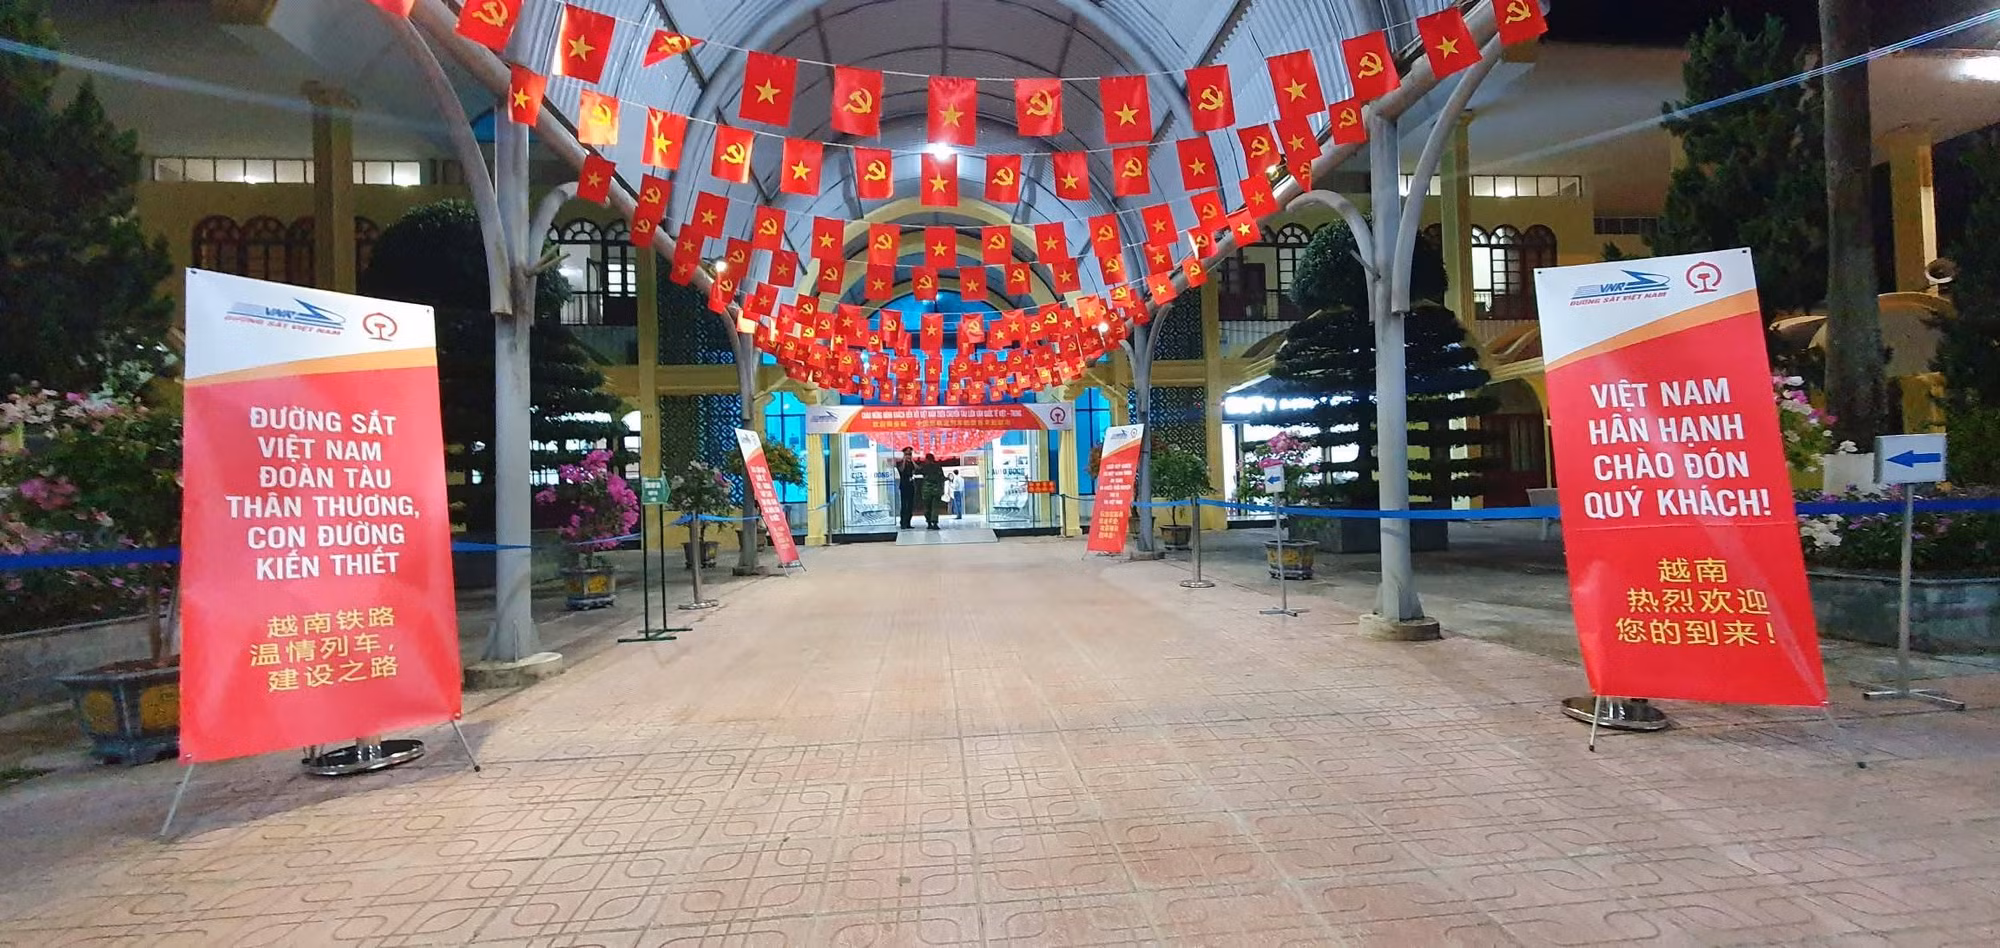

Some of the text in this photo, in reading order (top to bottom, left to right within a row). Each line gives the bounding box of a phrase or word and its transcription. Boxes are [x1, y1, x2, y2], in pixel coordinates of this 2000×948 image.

[1600, 282, 1626, 293] VNR
[1644, 291, 1667, 299] NAM
[1590, 378, 1730, 411] VIỆT NAM
[250, 405, 396, 436] ĐƯỜNG SẮT
[1589, 414, 1743, 449] HÂN HẠNH
[259, 434, 381, 462] VIỆT NAM
[260, 464, 391, 488] ĐOÀN TÀU
[1594, 448, 1749, 480] CHÀO ĐÓN
[226, 492, 420, 519] THÂN THƯƠNG,
[1585, 485, 1771, 519] QUÝ KHÁCH!
[249, 521, 405, 549] CON ĐƯỜNG
[256, 546, 399, 580] KIẾN THIẾT
[1658, 558, 1728, 583] 越南
[1627, 588, 1770, 614] 热烈欢迎
[268, 606, 395, 638] 越南铁路
[268, 655, 397, 693] 建设之路
